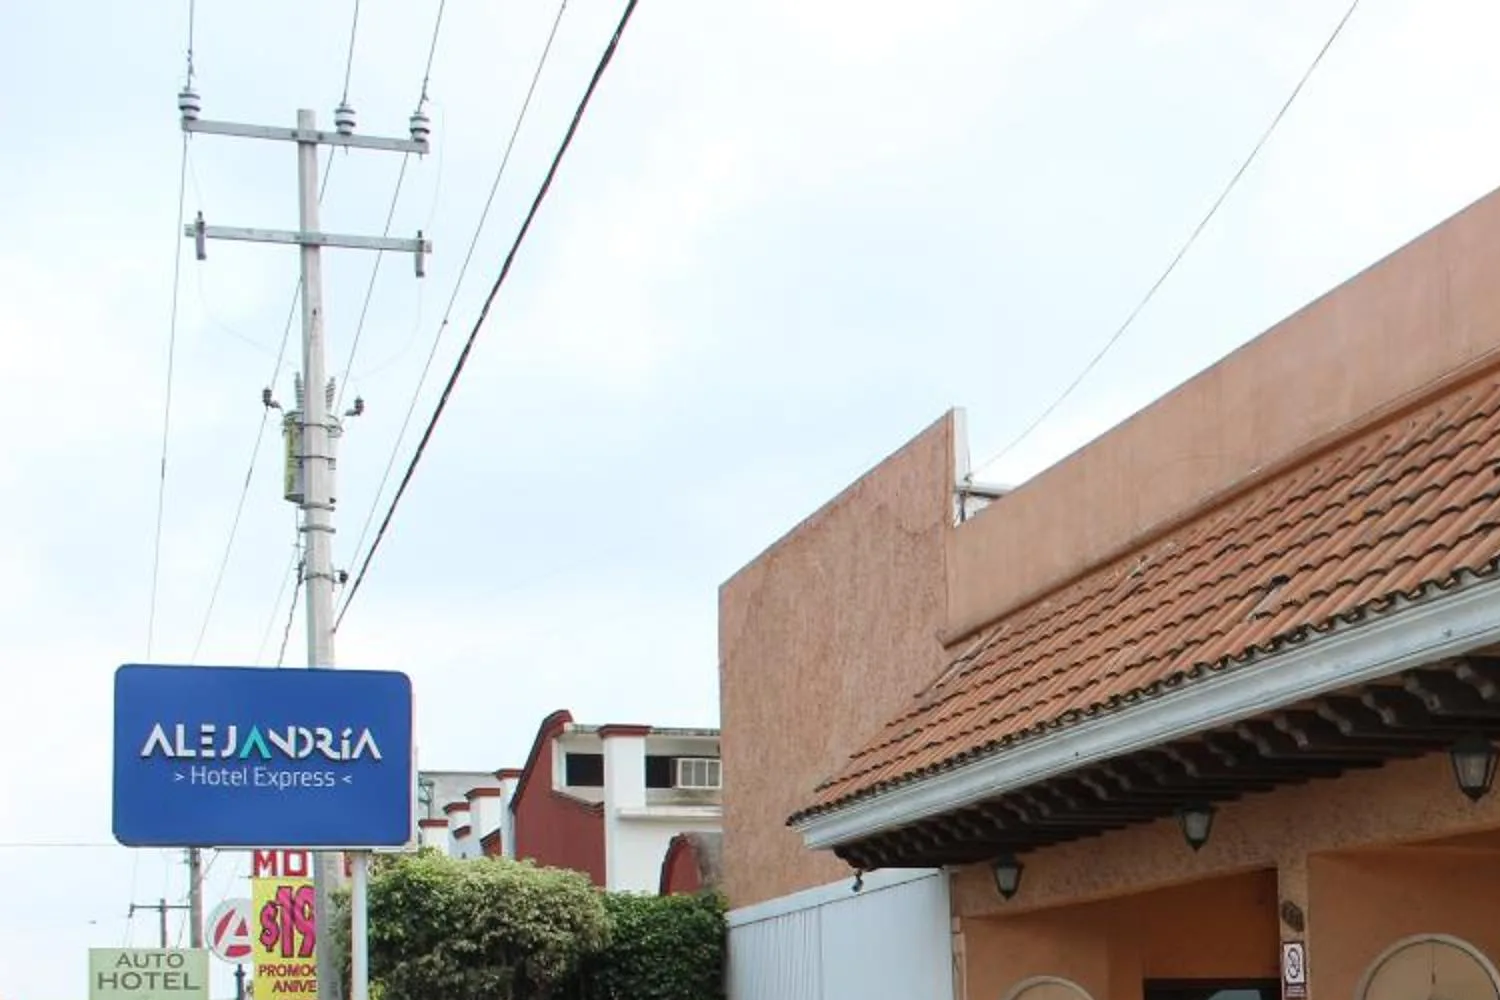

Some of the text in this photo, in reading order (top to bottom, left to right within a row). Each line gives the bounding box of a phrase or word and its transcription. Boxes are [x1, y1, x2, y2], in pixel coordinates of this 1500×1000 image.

[191, 766, 335, 790] Hotel Express
[254, 849, 309, 877] MO
[116, 952, 185, 969] AUTO
[98, 971, 202, 990] HOTEL
